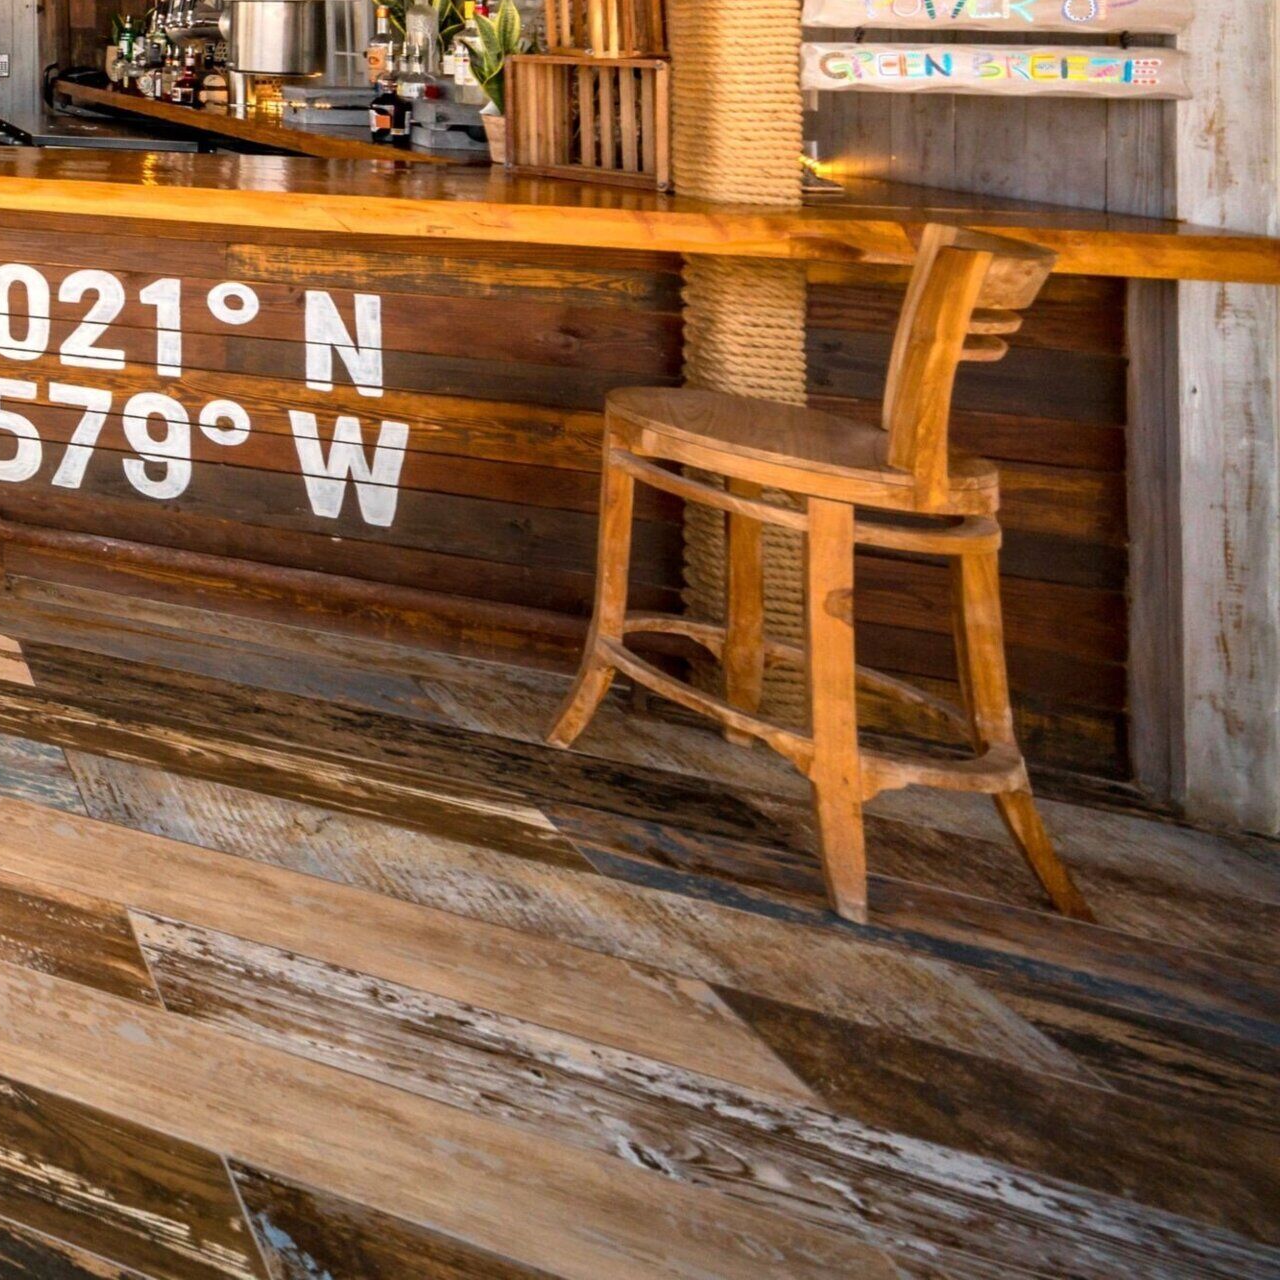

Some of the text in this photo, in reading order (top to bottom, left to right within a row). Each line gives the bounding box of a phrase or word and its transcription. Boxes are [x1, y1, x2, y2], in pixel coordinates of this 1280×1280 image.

[819, 51, 1163, 84] GREEN BREEZE
[303, 289, 384, 398] N
[287, 408, 411, 528] W
